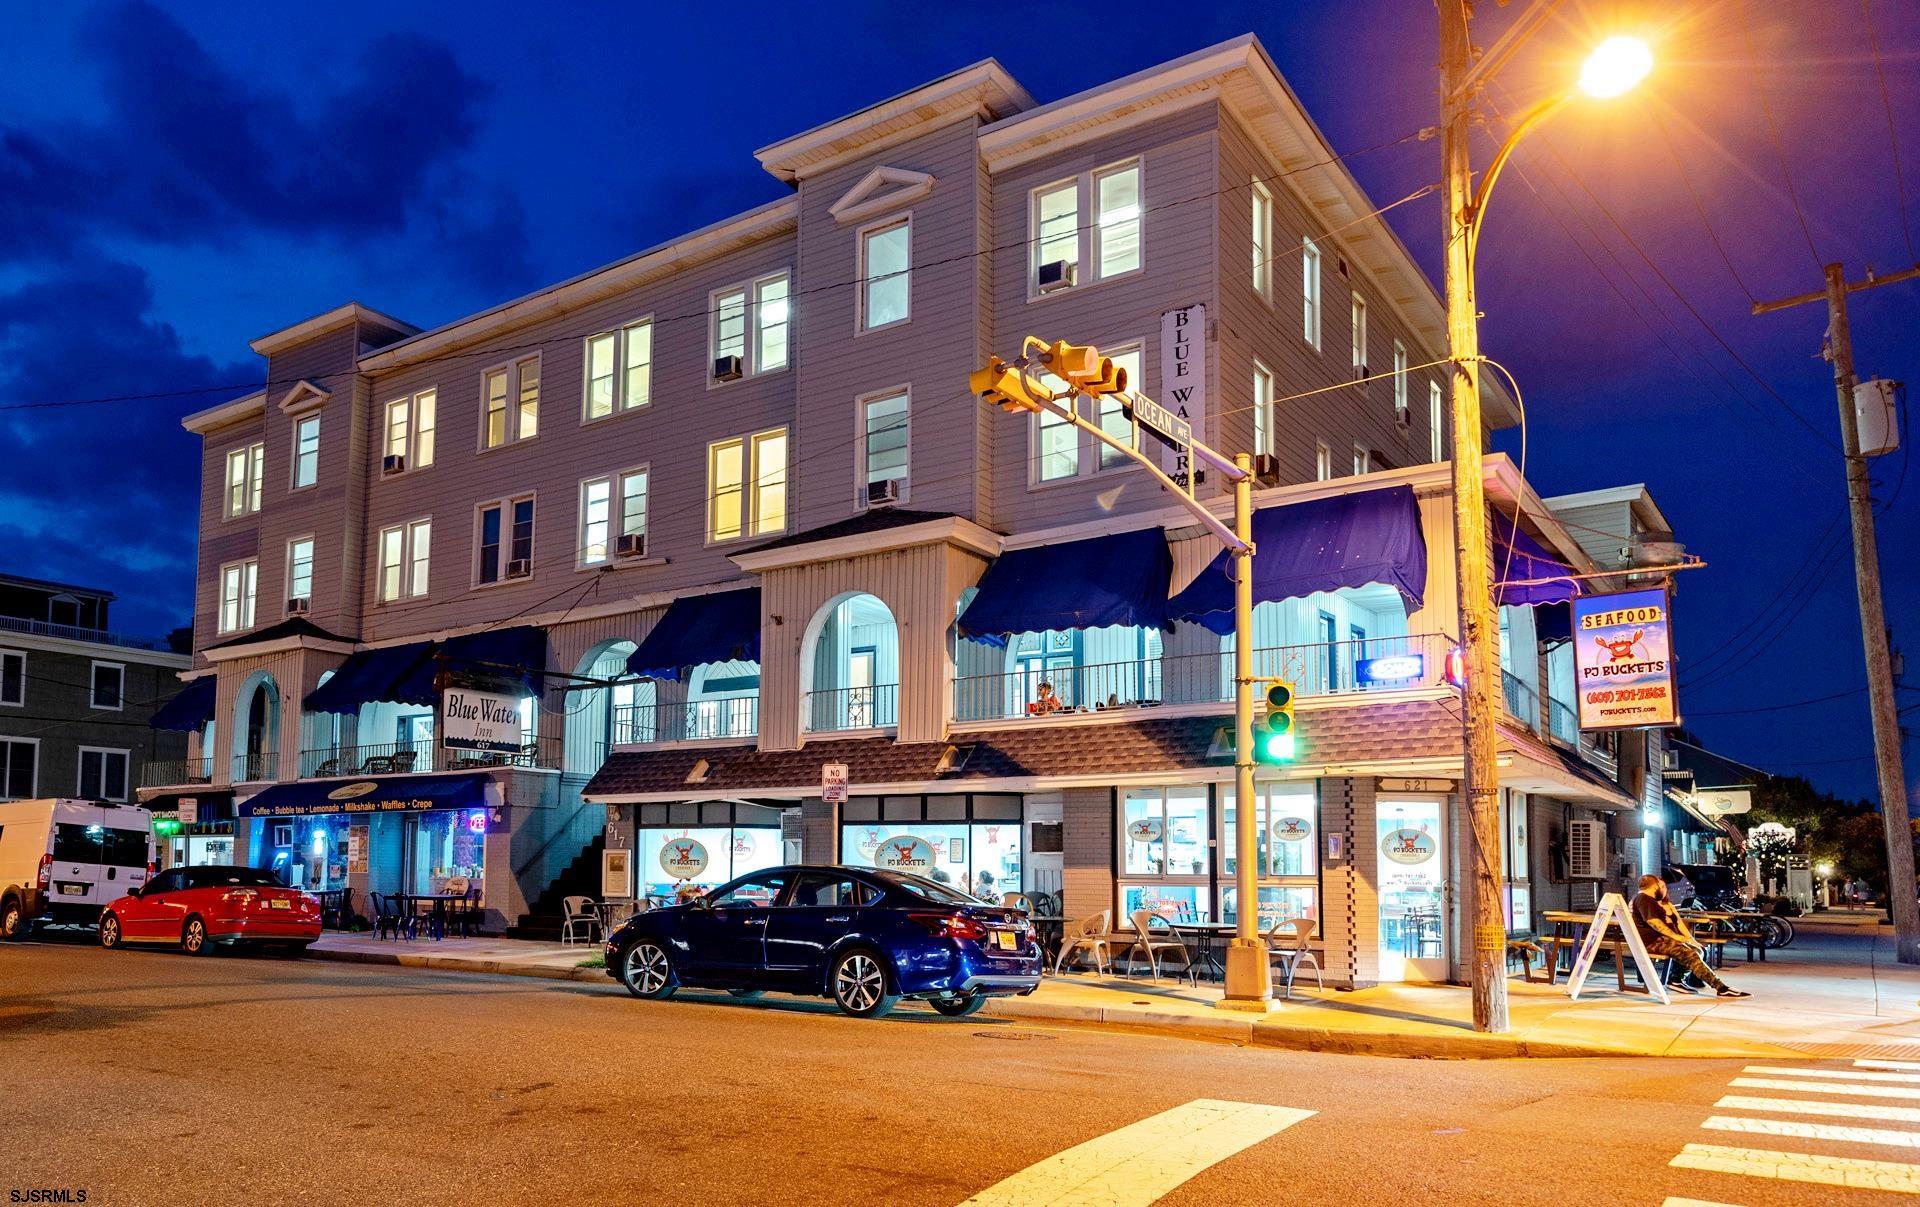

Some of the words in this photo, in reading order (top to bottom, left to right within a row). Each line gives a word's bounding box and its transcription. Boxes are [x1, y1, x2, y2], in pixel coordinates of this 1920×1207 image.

[1175, 312, 1190, 378] BLUE
[1137, 396, 1172, 435] OCEAN
[1585, 608, 1657, 628] SEAFOOD
[1584, 667, 1602, 678] PJ
[1603, 661, 1665, 676] BUCKETS
[1587, 690, 1615, 704] (609)
[447, 694, 479, 721] Blue
[480, 698, 518, 725] Water
[1600, 707, 1657, 717] PJBUCKETS.com
[474, 722, 493, 738] Inn
[476, 741, 491, 750] 617
[830, 769, 841, 777] NO
[1404, 780, 1428, 791] 621
[252, 807, 271, 815] Coffee
[275, 805, 295, 815] Bubble
[296, 805, 305, 814] tea
[309, 804, 340, 813] Lemonade
[344, 802, 376, 812] Milkshake
[381, 799, 406, 810] Waffles
[412, 798, 433, 809] Crepe
[607, 821, 625, 848] 617
[678, 858, 700, 866] BUCKETS
